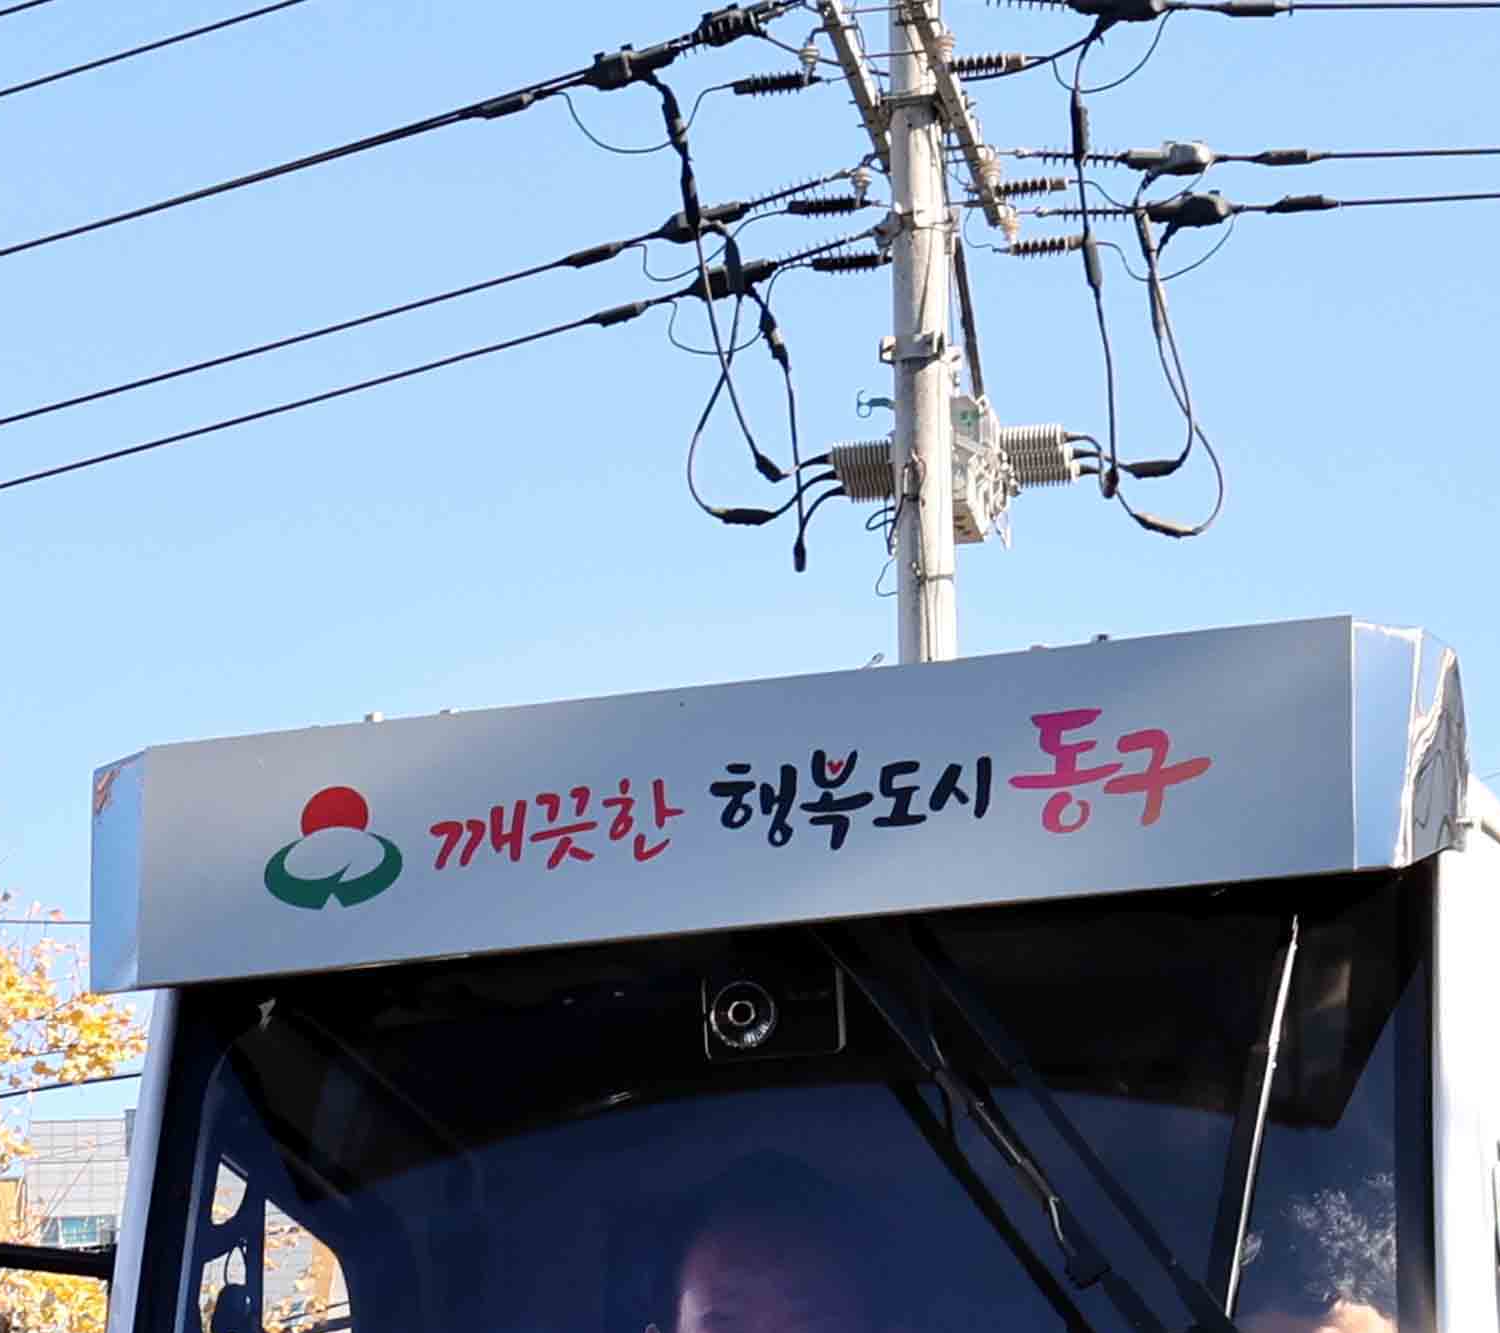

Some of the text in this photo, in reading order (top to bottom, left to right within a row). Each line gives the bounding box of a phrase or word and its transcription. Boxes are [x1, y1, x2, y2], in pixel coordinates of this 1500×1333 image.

[429, 708, 1213, 869] 깨끗한 행복도시 동구
